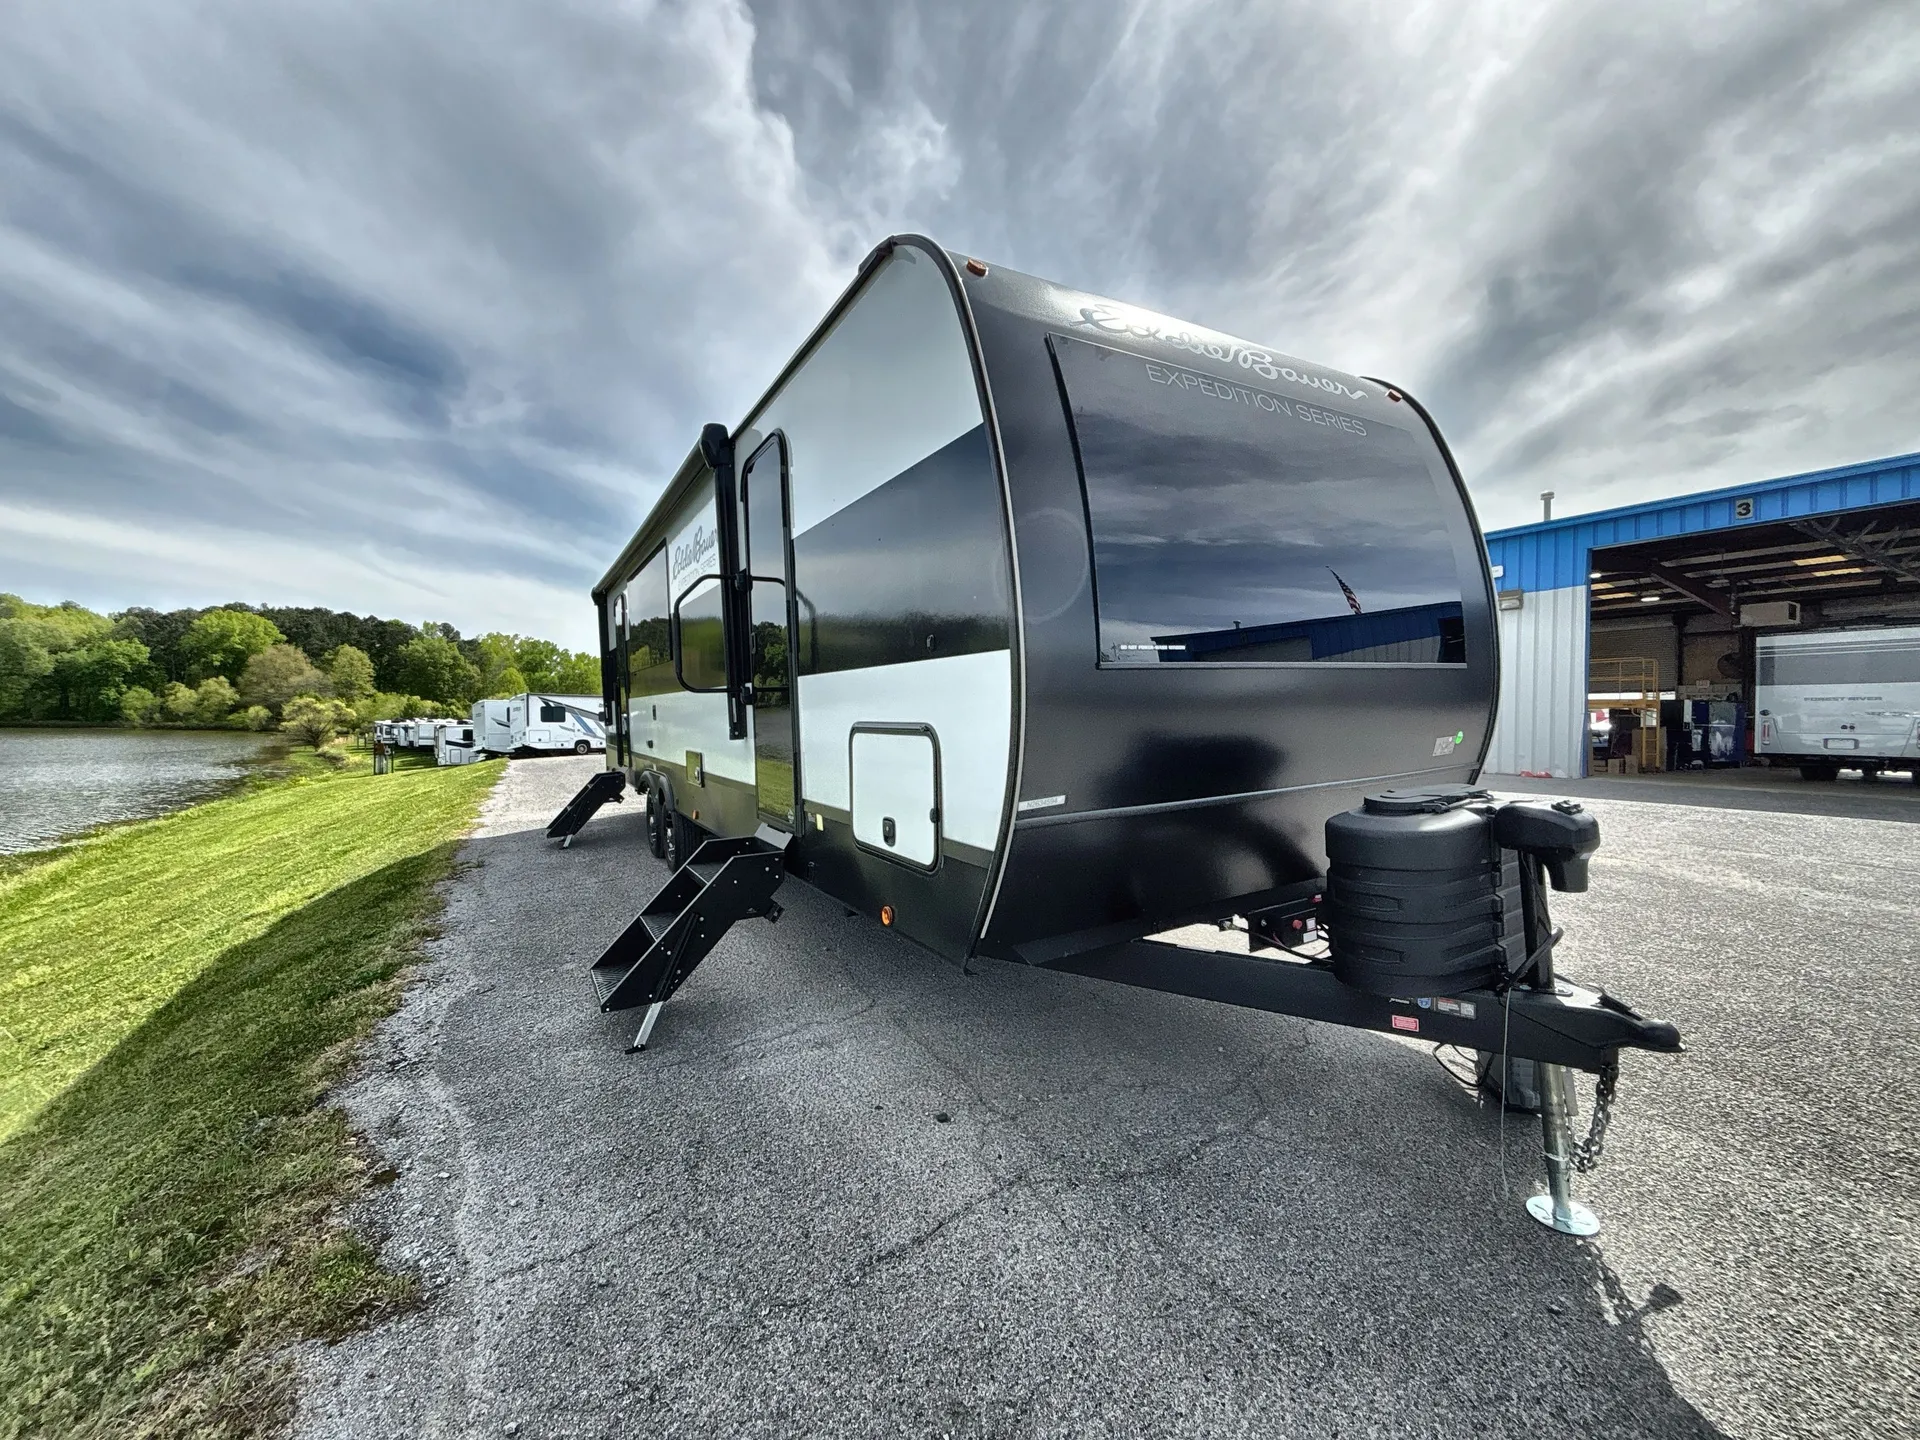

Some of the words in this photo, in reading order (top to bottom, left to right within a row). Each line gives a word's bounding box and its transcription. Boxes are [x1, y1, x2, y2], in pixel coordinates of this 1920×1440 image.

[1069, 303, 1229, 363] Eddie
[1224, 345, 1369, 400] Bauer
[1145, 363, 1292, 417] EXPEDITION
[1295, 404, 1367, 436] SERIES
[1736, 501, 1751, 516] 3
